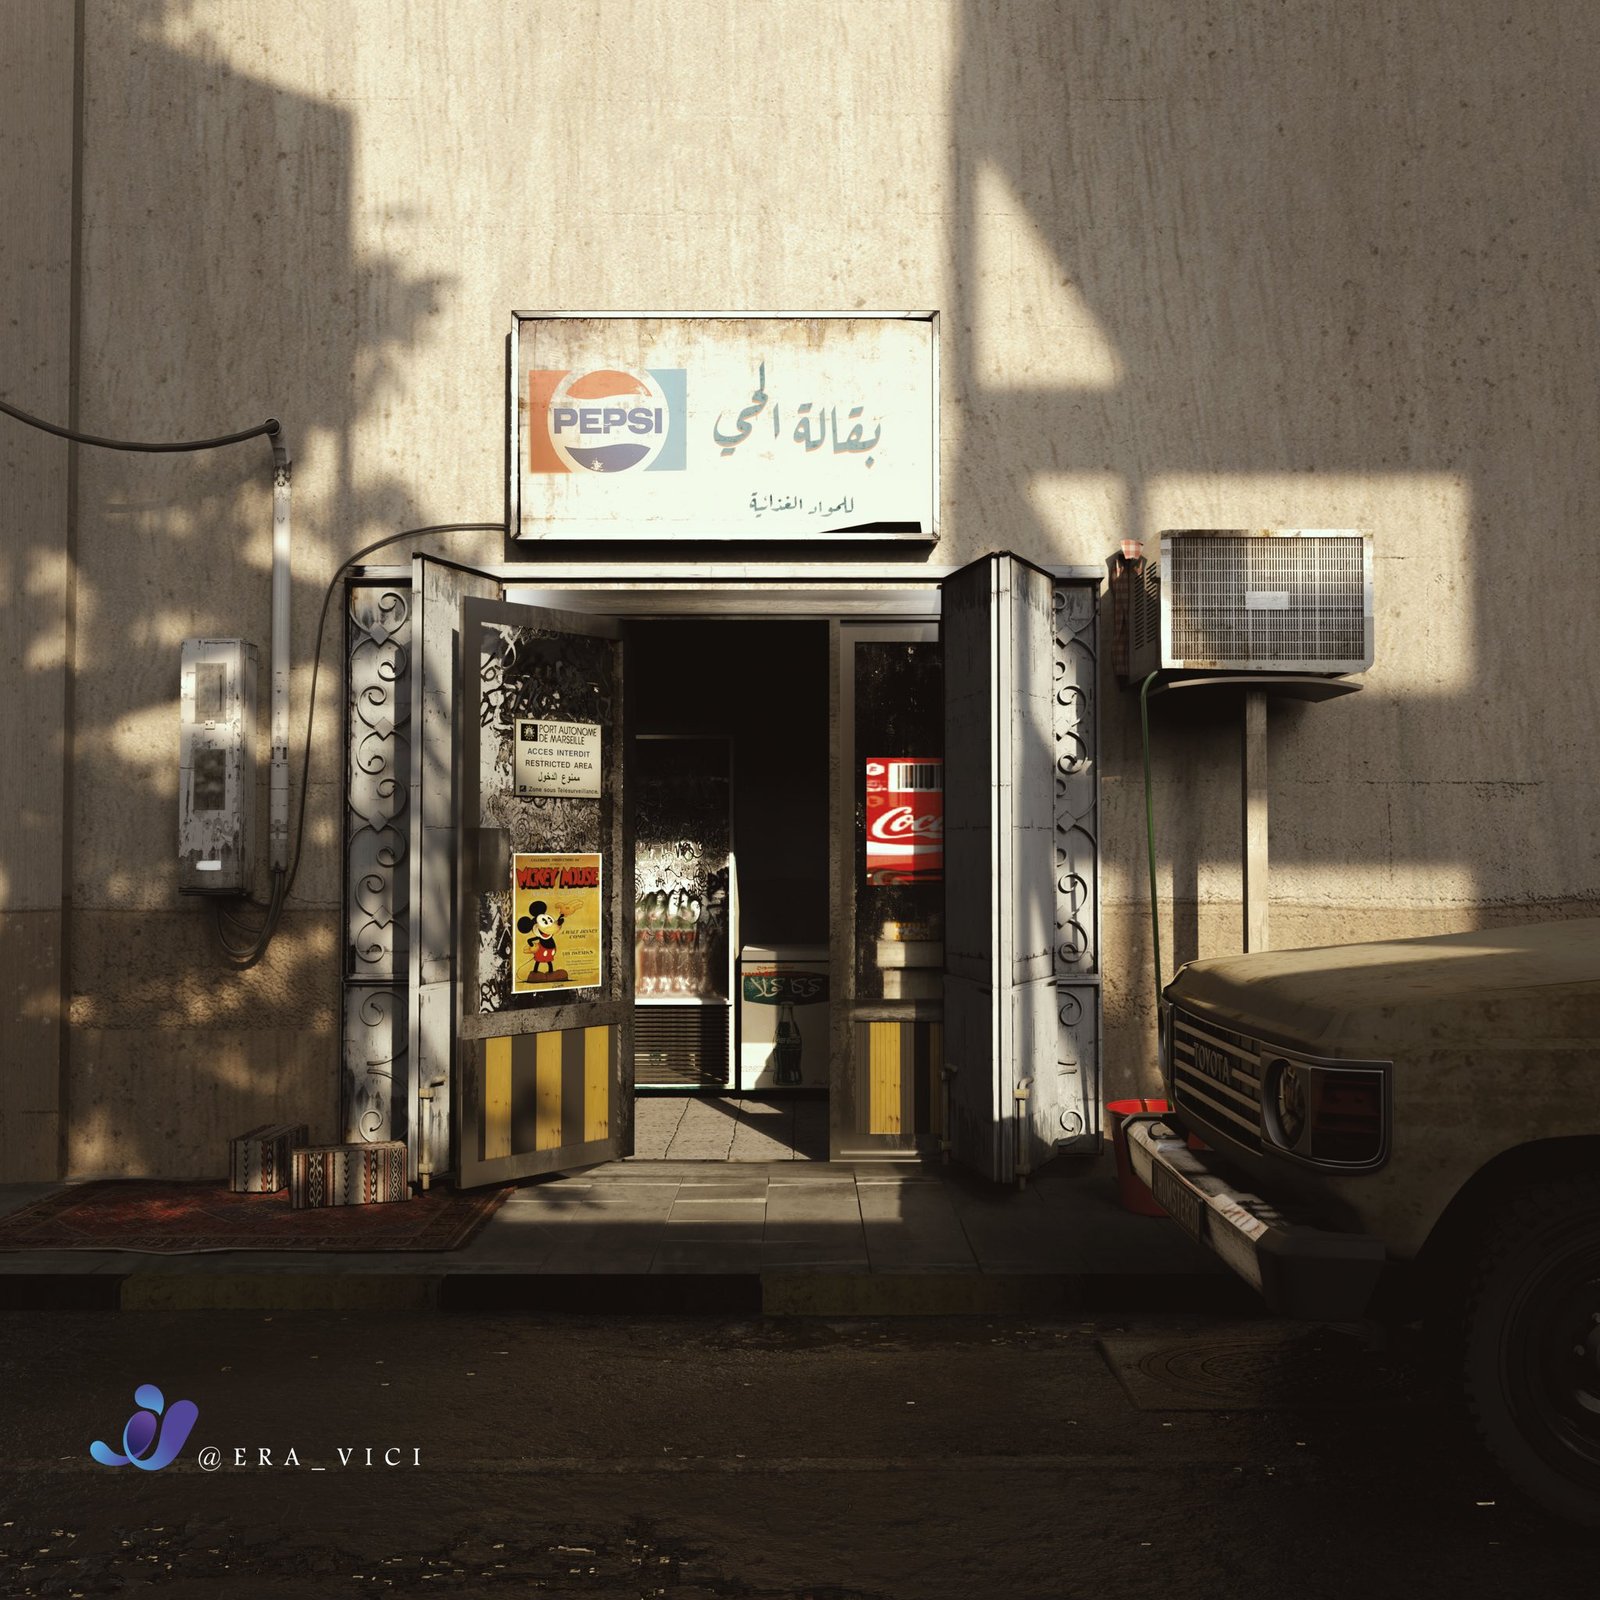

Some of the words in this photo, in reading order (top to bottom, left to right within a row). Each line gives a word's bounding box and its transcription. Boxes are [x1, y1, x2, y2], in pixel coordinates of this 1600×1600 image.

[713, 361, 780, 457] الحي
[553, 407, 663, 434] PEPSI
[793, 402, 881, 469] بقالة
[750, 492, 802, 518] الغذائية
[808, 496, 854, 517] للمواد
[539, 724, 557, 734] PORT
[559, 726, 597, 737] AUTONOME
[539, 734, 548, 742] DE
[550, 735, 585, 745] MARSEILLE
[527, 748, 554, 756] ACCES
[557, 749, 590, 758] INTERDIT
[525, 760, 570, 769] RESTRICTED
[538, 771, 557, 782] الدخول
[561, 773, 580, 785] ممنوع
[516, 867, 559, 889] MICKEY
[559, 867, 599, 889] MOUSE
[1193, 1041, 1231, 1085] TOYOTA
